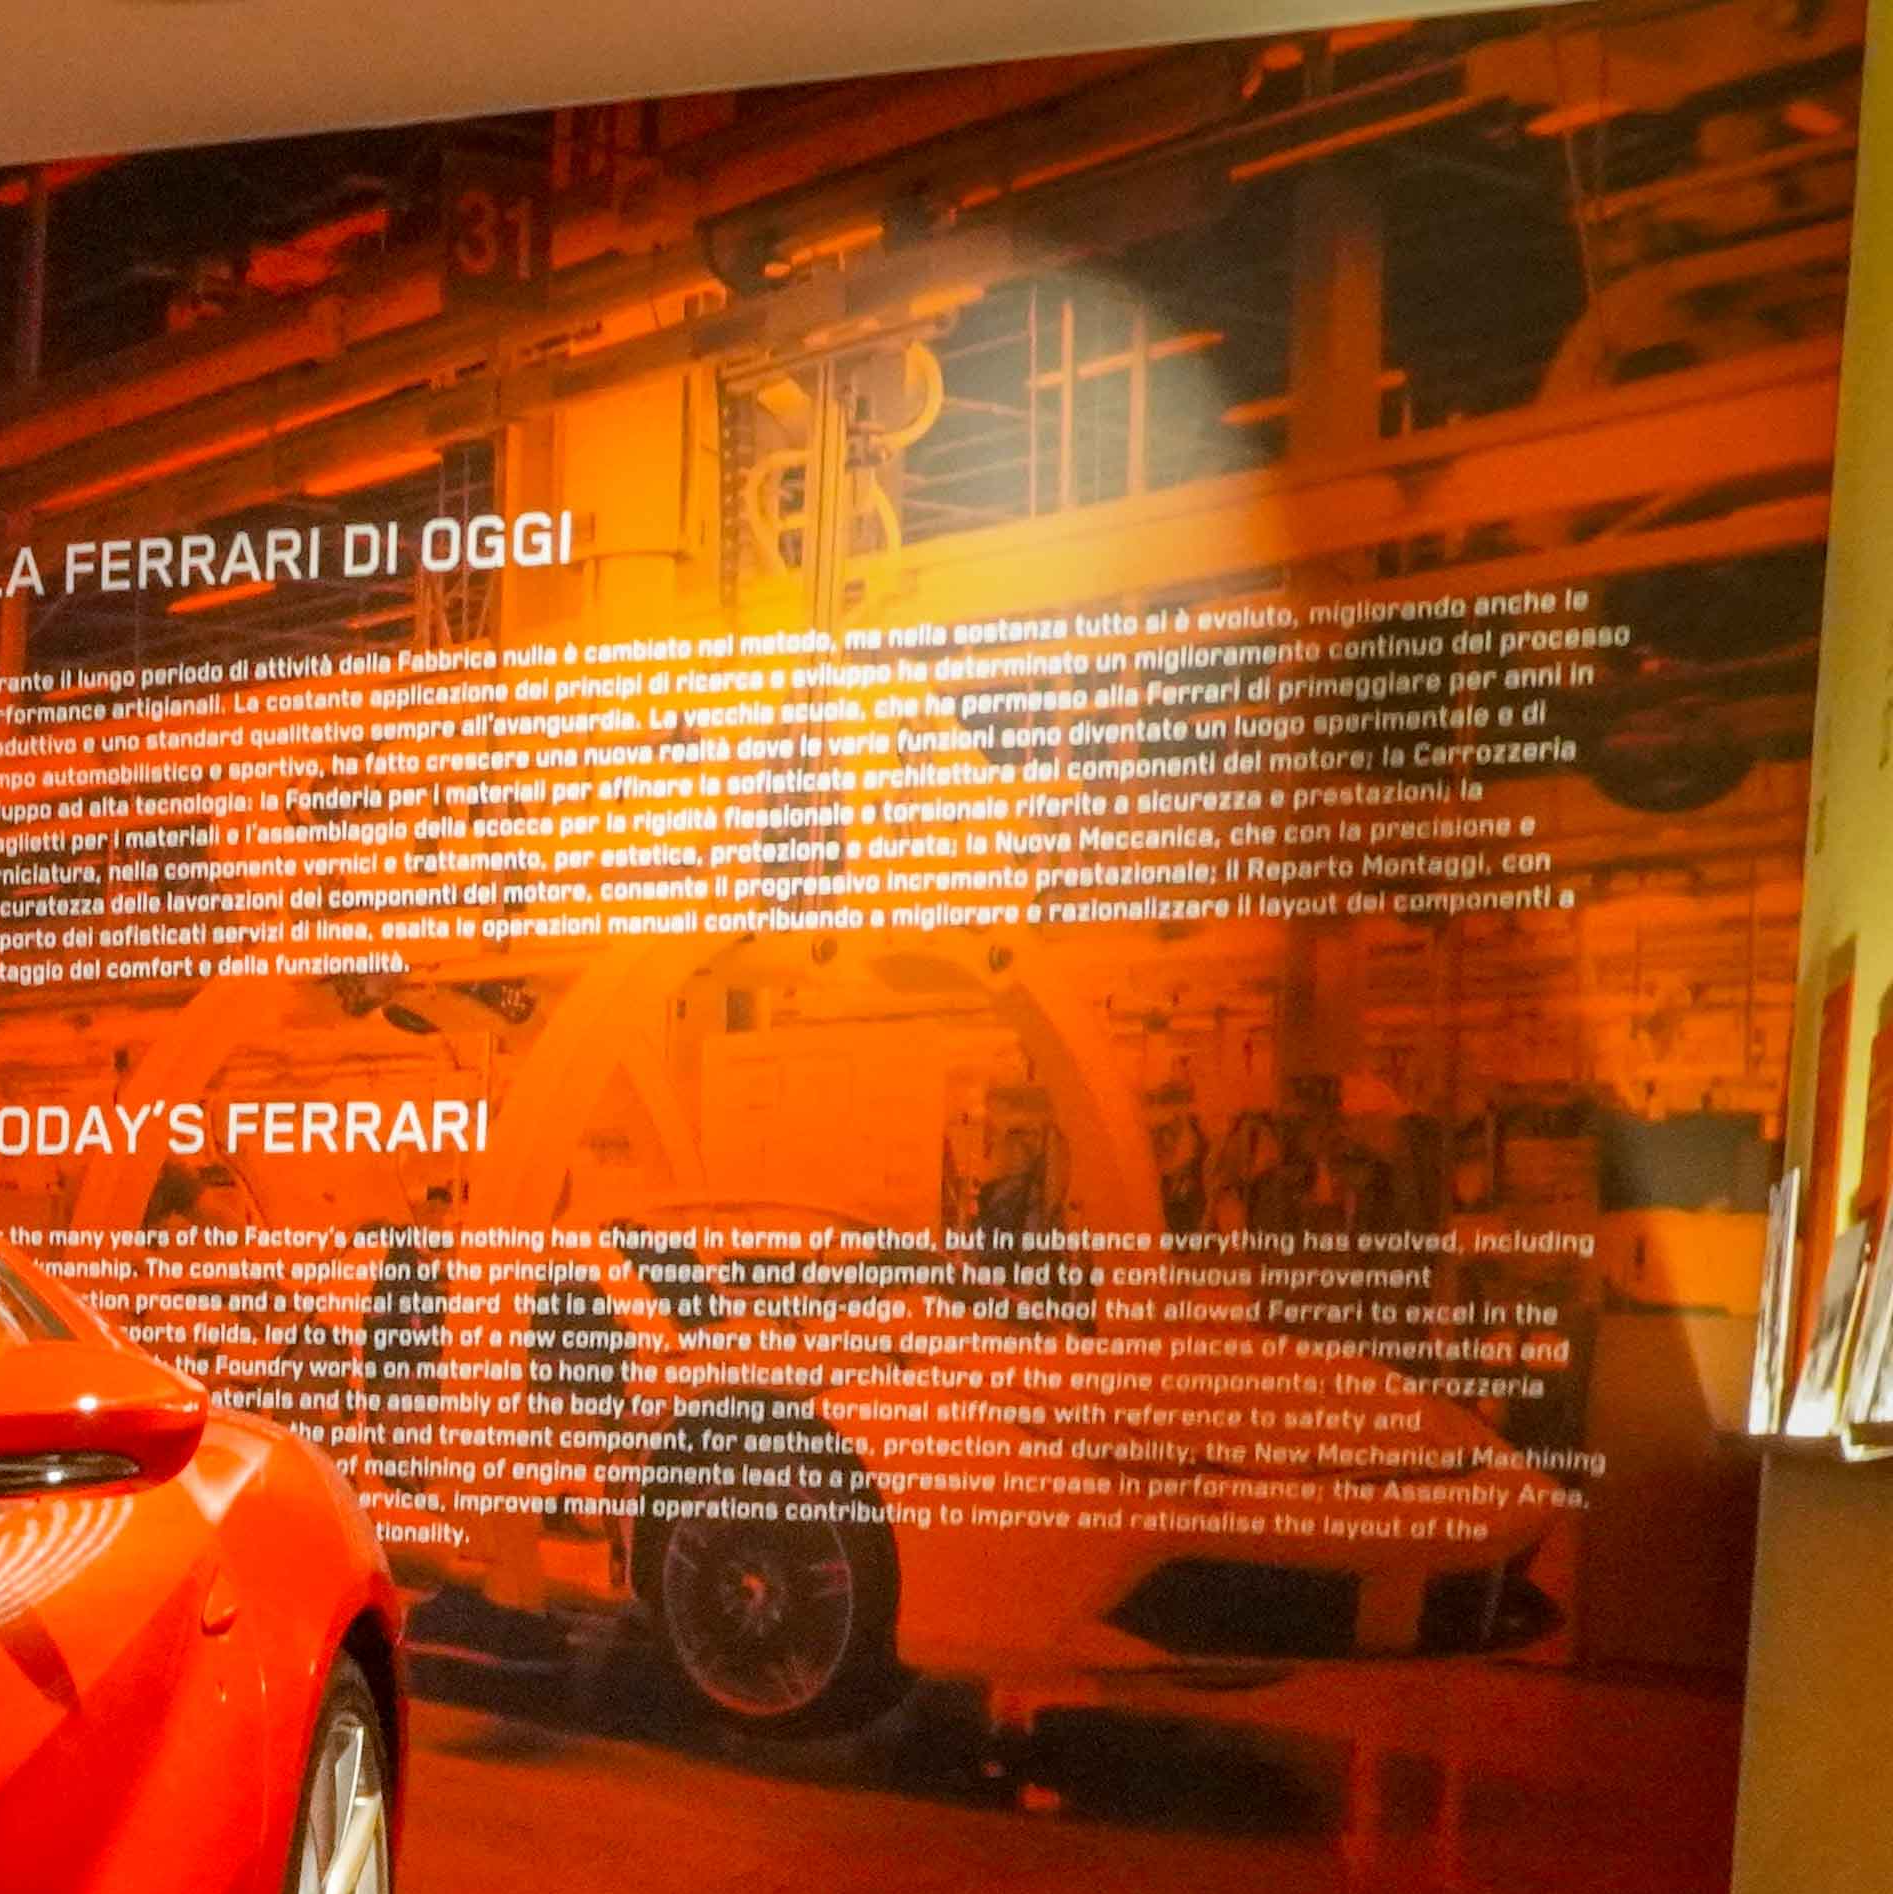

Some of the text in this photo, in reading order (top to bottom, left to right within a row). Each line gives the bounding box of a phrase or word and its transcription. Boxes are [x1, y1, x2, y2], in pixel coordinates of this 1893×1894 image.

[65, 526, 321, 593] FERRARI
[344, 521, 398, 577] DI
[420, 511, 573, 572] OGGI
[60, 669, 72, 689] il
[77, 668, 136, 693] lungo
[141, 661, 223, 690] periodo
[229, 659, 249, 682] di
[254, 654, 333, 681] attività
[339, 652, 392, 675] della
[397, 649, 498, 672] Fabbrica
[502, 645, 558, 667] nulla
[584, 639, 694, 664] cambiato
[697, 634, 734, 658] nel
[844, 629, 882, 650] ma
[887, 623, 948, 648] nella
[954, 619, 1069, 644] sostanza
[1074, 613, 1139, 637] tutto
[1309, 596, 1467, 628] migliorando
[1474, 591, 1556, 617] anche
[1565, 588, 1589, 610] le
[234, 693, 260, 714] La
[265, 689, 364, 712] costante
[369, 683, 509, 709] applicazione
[554, 676, 643, 704] principi
[647, 671, 670, 695] di
[674, 671, 764, 693] ricerca
[768, 669, 786, 689] e
[792, 662, 894, 689] sviluppo
[897, 658, 931, 682] ha
[936, 651, 1089, 681] determinato
[1095, 652, 1127, 673] un
[1133, 640, 1315, 675] miglioramento
[1328, 634, 1444, 660] continuo
[1499, 626, 1631, 658] processo
[106, 956, 193, 979] comfort
[198, 959, 212, 977] e
[217, 955, 269, 976] della
[226, 1099, 490, 1154] FERRARI
[9, 1226, 43, 1246] the
[48, 1230, 105, 1249] many
[110, 1229, 170, 1250] years
[175, 1225, 199, 1247] of
[203, 1226, 239, 1247] the
[244, 1225, 347, 1250] Factory's
[353, 1227, 455, 1249] activities
[460, 1227, 545, 1253] nothing
[551, 1228, 592, 1249] has
[598, 1226, 697, 1254] changed
[703, 1227, 725, 1248] in
[730, 1228, 802, 1249] terms
[808, 1226, 834, 1250] of
[945, 1227, 986, 1250] but
[992, 1228, 1014, 1250] in
[1021, 1228, 1152, 1251] substance
[1159, 1229, 1295, 1255] everything
[1303, 1230, 1350, 1252] has
[1474, 1230, 1595, 1258] including
[33, 1257, 1431, 1290] manship. The constant application of the principles of research and development has led to a continuous improvement
[358, 1489, 1488, 1541] ervices, improves manual operations contributing to improve and rationalise the layout of the
[375, 1521, 470, 1547] tionality.
